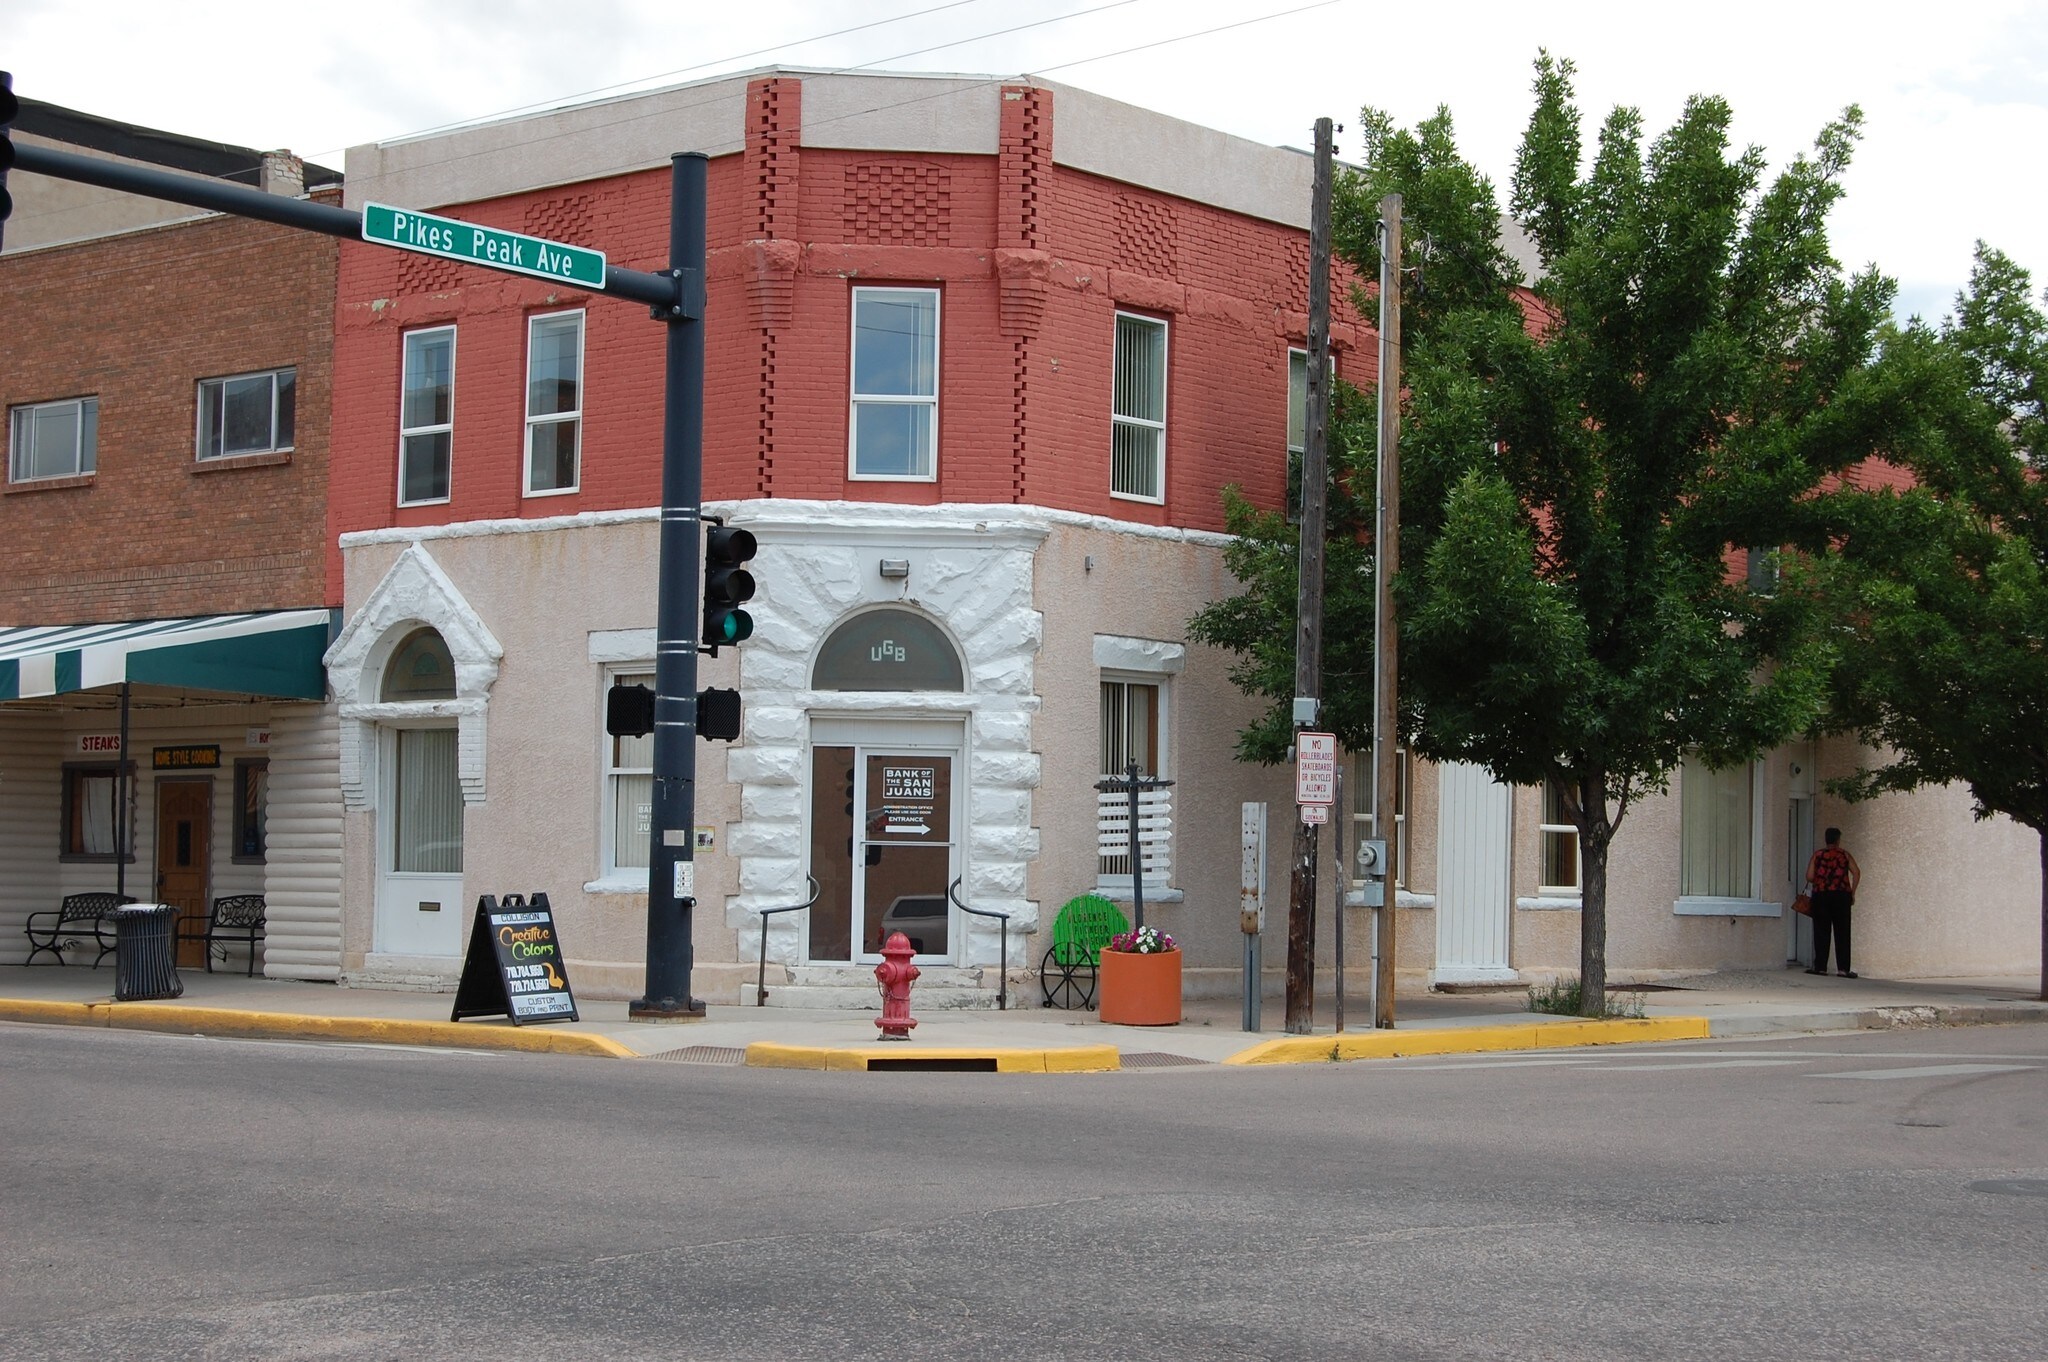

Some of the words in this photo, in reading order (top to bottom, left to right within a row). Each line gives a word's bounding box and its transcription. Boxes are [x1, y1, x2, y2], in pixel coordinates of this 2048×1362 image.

[393, 212, 453, 251] Pikes
[472, 229, 522, 266] Peak
[537, 244, 573, 277] Ave
[871, 640, 906, 662] UGB
[82, 735, 120, 751] STEAKS
[1312, 740, 1322, 750] NO
[155, 750, 171, 766] HOME
[172, 749, 190, 766] STYLE
[191, 748, 217, 765] COOKING
[1301, 751, 1333, 761] ROLLERBLADES
[1302, 762, 1332, 771] SKATEBOARDS
[886, 769, 919, 778] BANK
[1302, 773, 1308, 781] OR
[1310, 773, 1331, 782] BICYCLES
[903, 778, 931, 787] SAN
[1306, 783, 1327, 792] ALLOWED
[886, 787, 932, 797] JUANS
[501, 913, 541, 923] COLLISION
[500, 926, 550, 947] Creative
[512, 941, 554, 960] Colors
[527, 996, 556, 1005] CUSTOM
[518, 1005, 536, 1014] BODY
